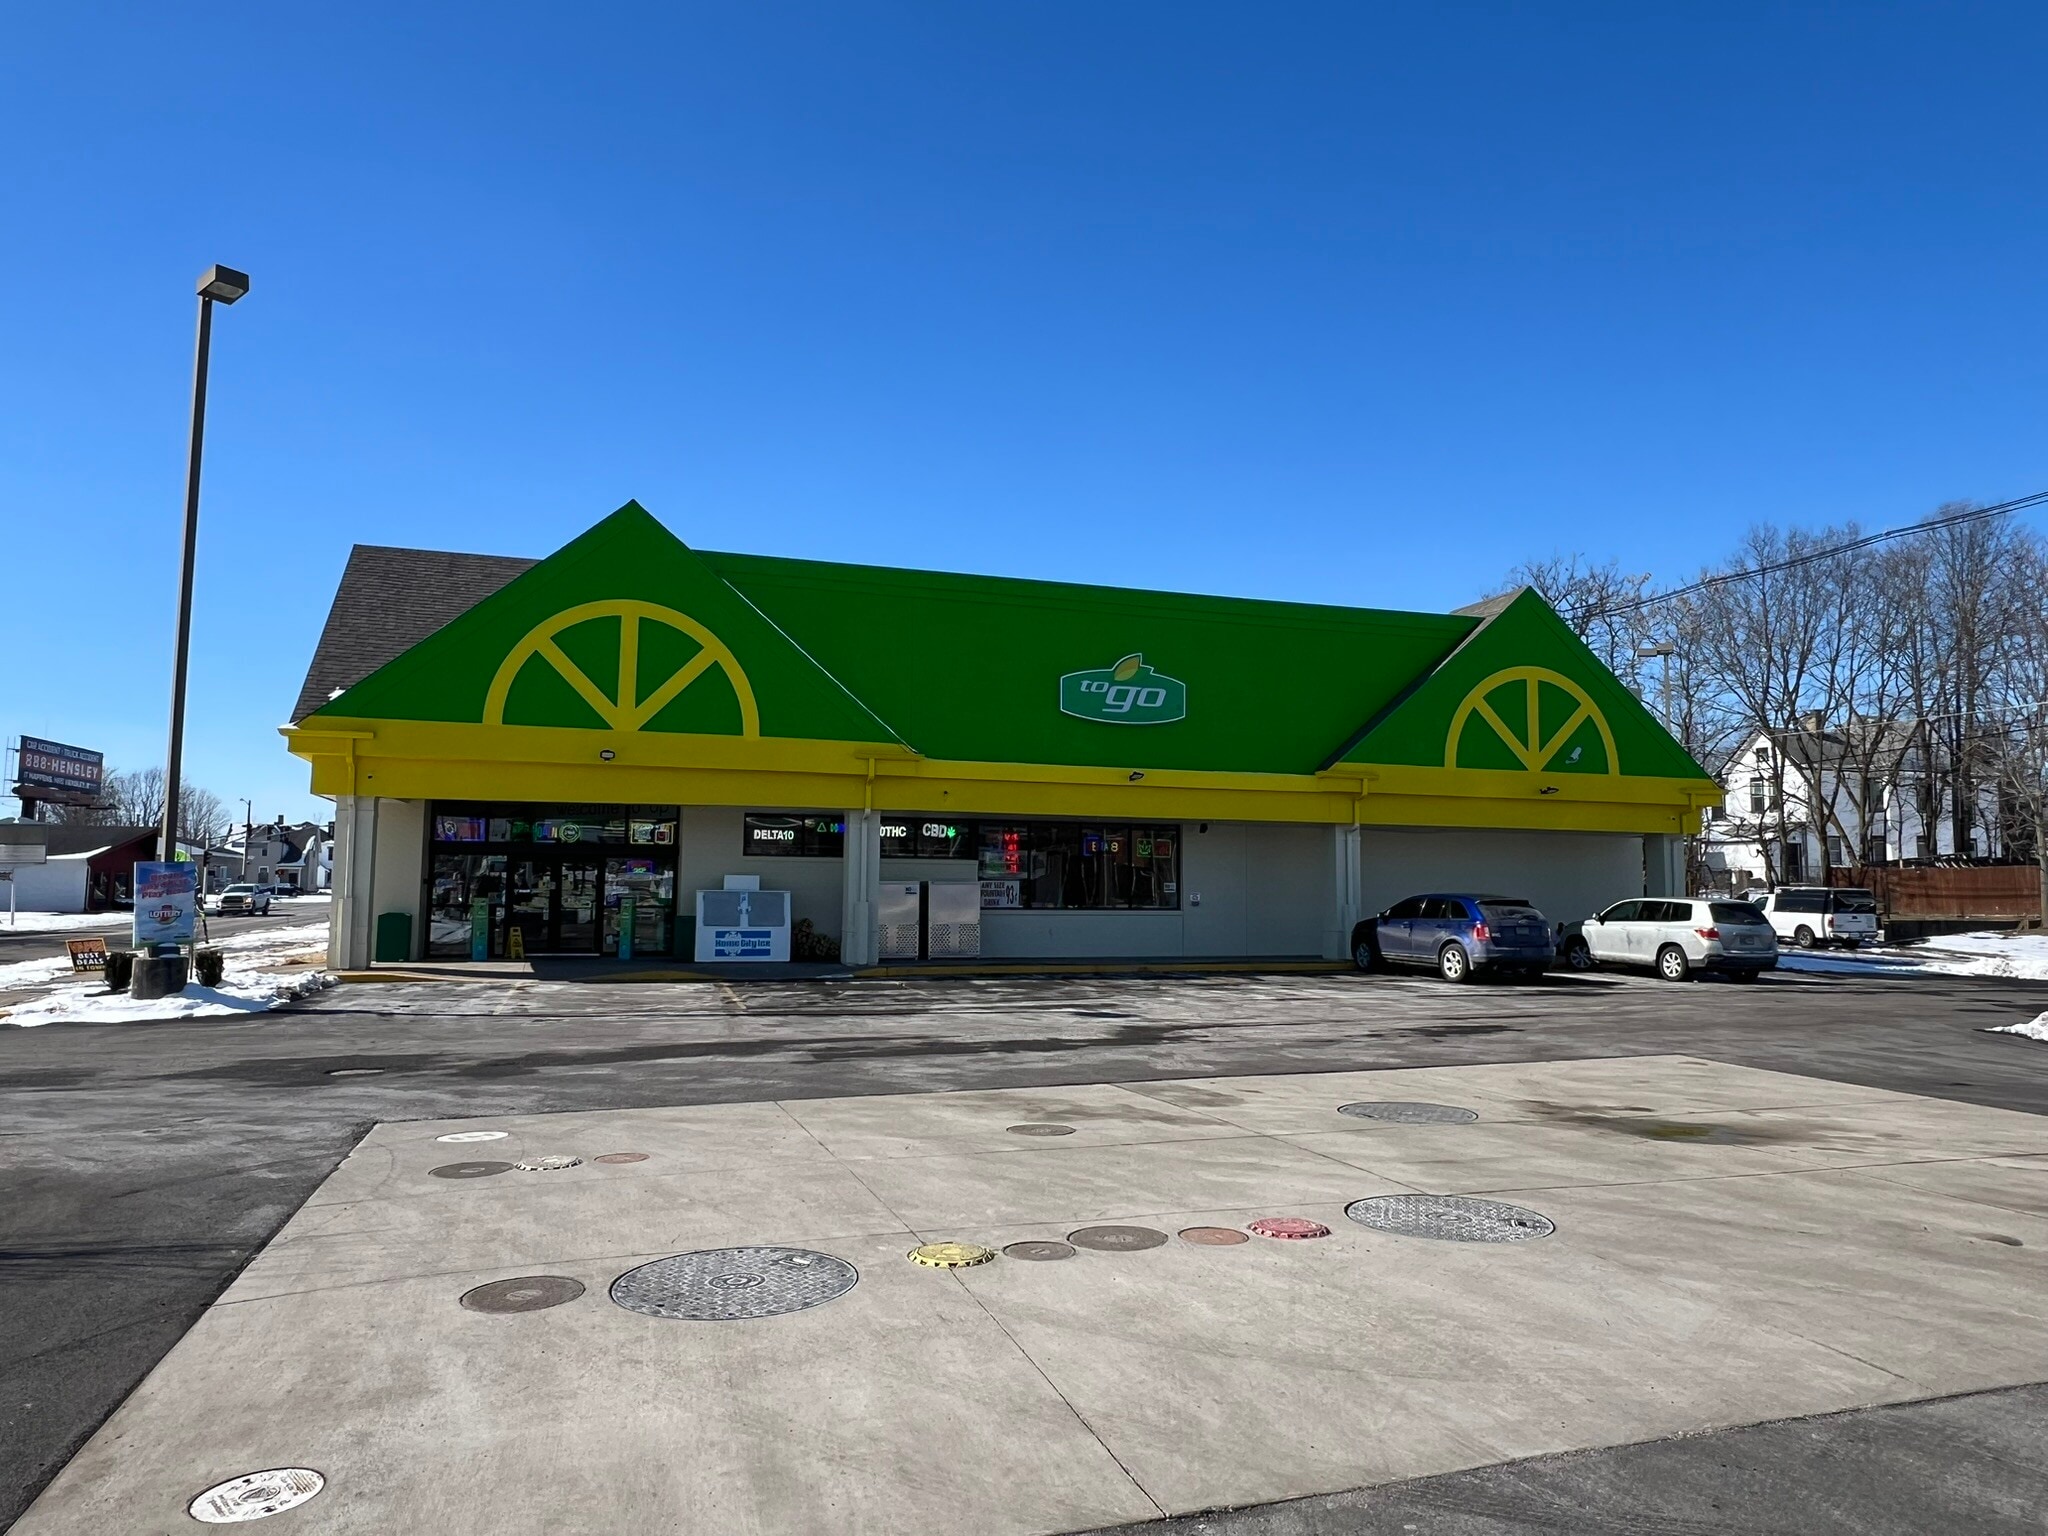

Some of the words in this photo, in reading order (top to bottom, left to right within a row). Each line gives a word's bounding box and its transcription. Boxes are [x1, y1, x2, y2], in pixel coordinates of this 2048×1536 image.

[25, 753, 98, 779] 888-HENSLEY
[753, 829, 794, 840] DELTA10
[922, 823, 947, 838] CBD
[715, 939, 740, 948] Home
